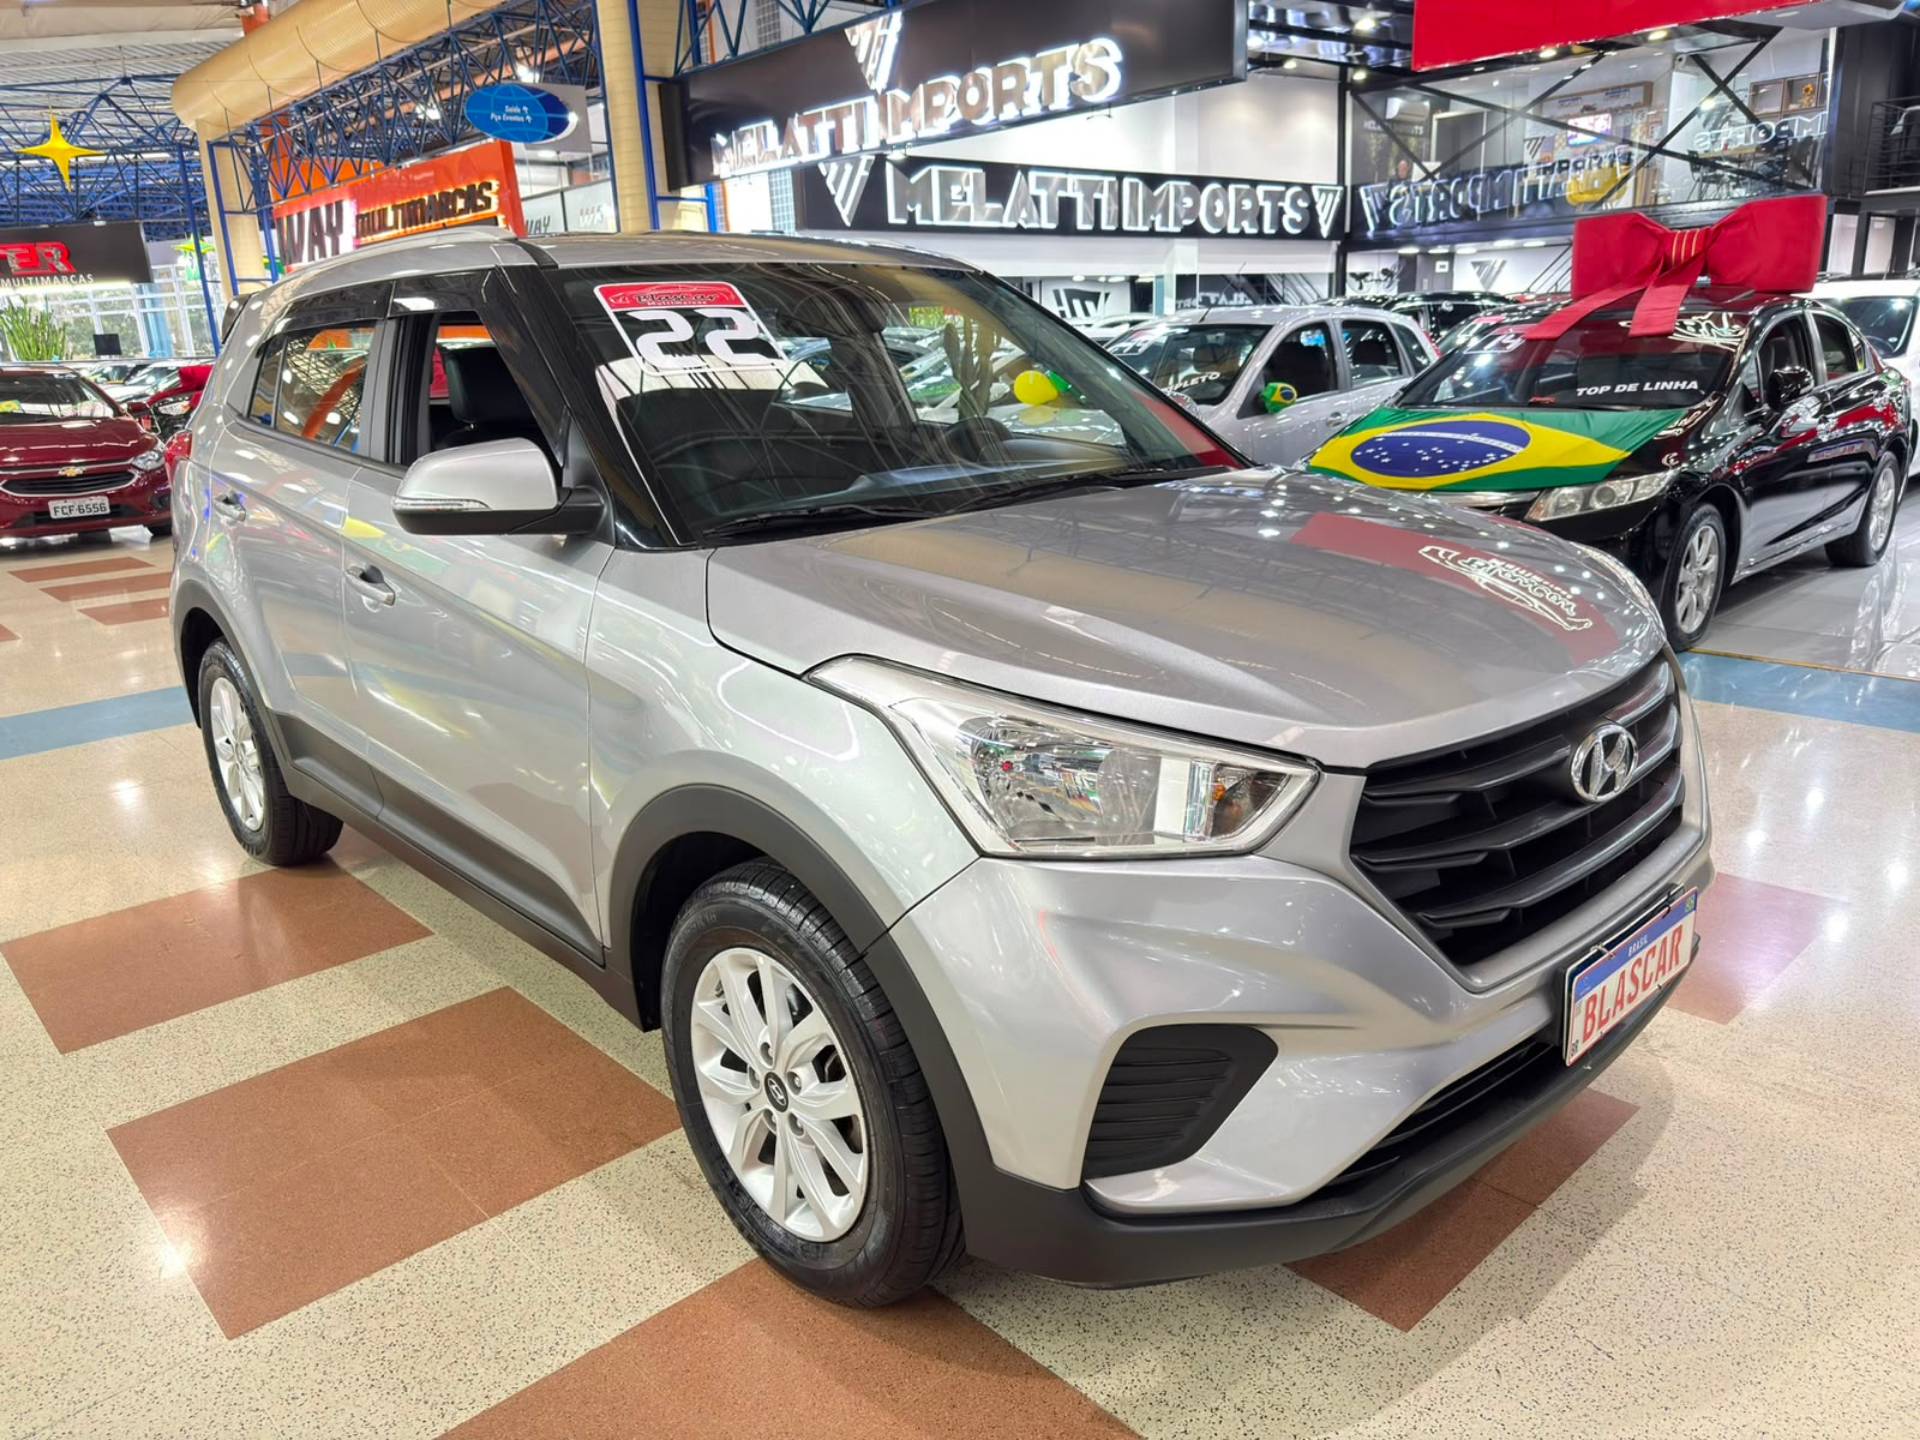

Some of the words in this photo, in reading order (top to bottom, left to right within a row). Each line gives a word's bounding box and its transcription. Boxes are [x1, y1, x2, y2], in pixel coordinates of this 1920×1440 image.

[711, 99, 878, 179] MELATTI
[878, 36, 1123, 146] IMPORTS
[355, 181, 493, 240] MULTIMARCAS
[885, 162, 1117, 230] MELATTI
[1121, 176, 1310, 234] IMPORTS
[276, 199, 344, 267] WAY
[625, 308, 778, 370] 22
[1576, 385, 1612, 397] TOP
[1614, 383, 1640, 393] DE
[1643, 380, 1699, 392] LINHA
[1582, 923, 1683, 1044] BLASCAR
